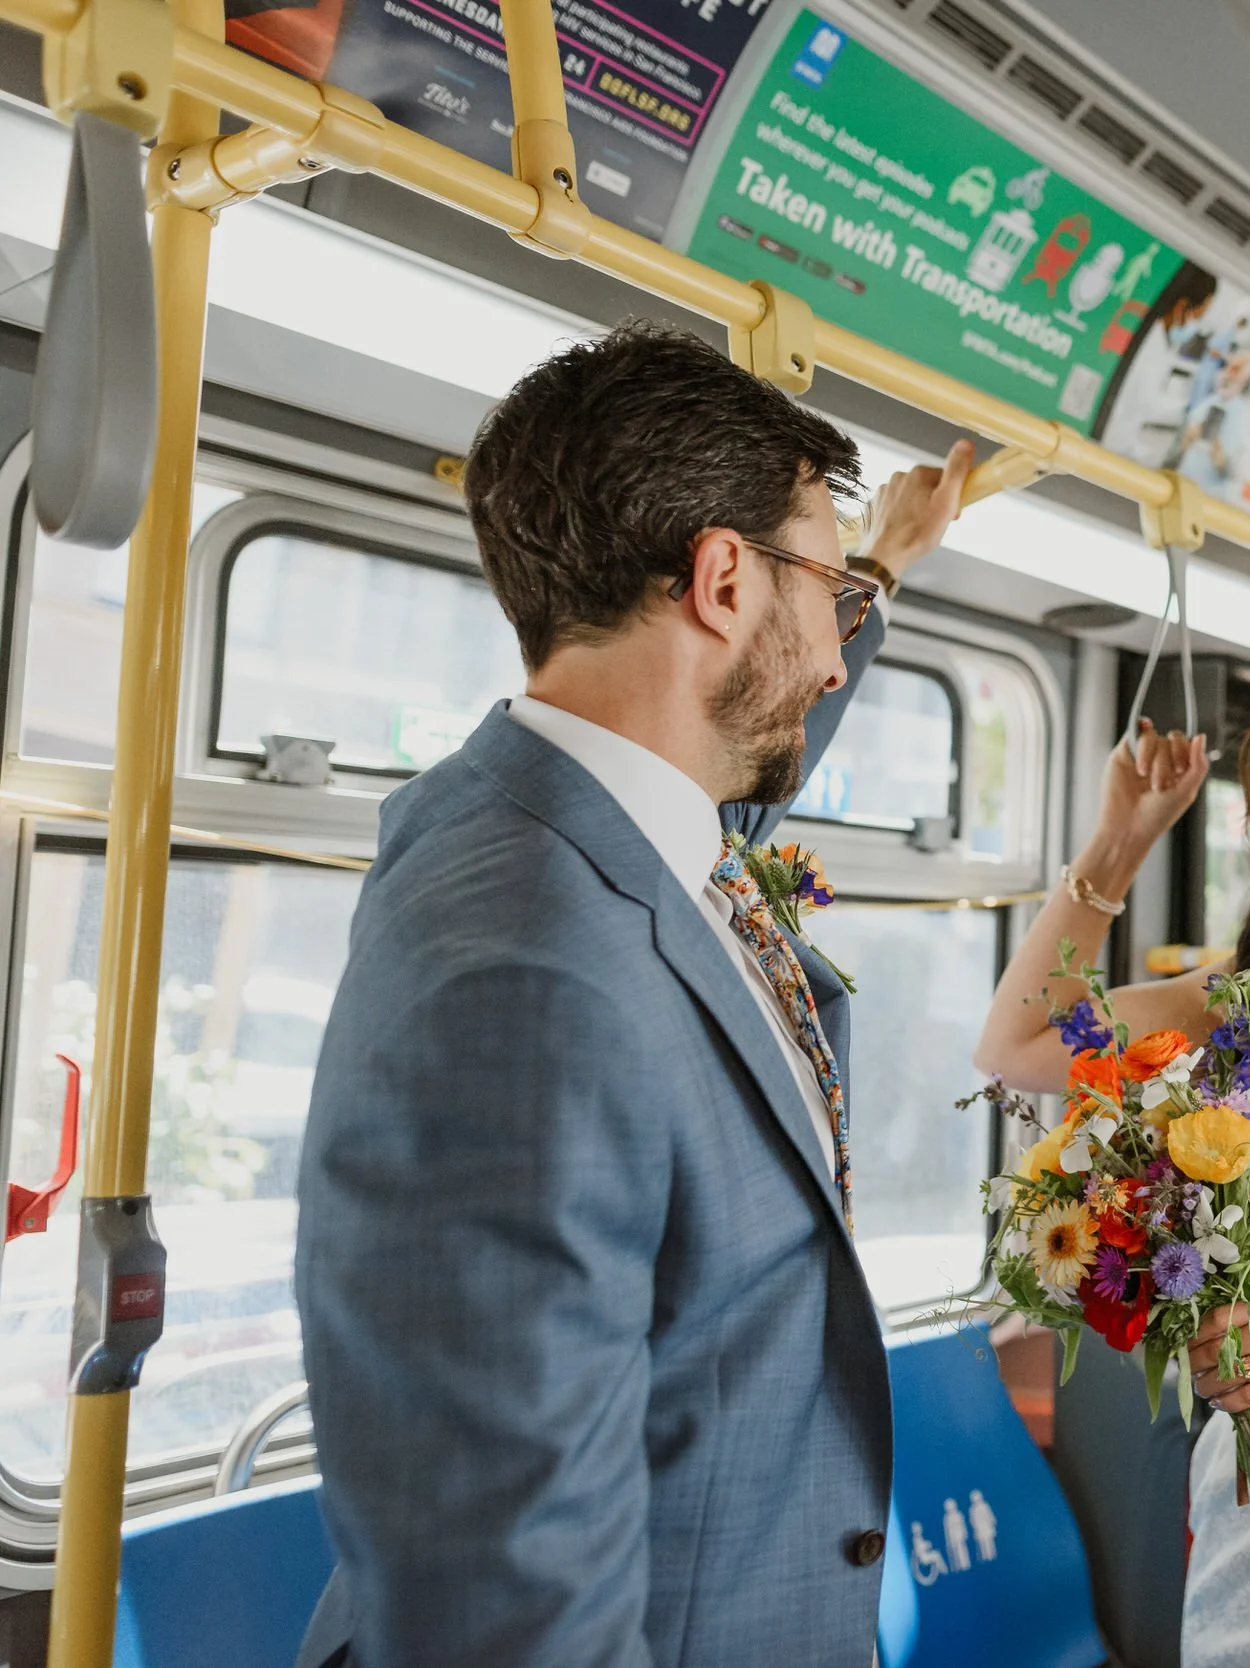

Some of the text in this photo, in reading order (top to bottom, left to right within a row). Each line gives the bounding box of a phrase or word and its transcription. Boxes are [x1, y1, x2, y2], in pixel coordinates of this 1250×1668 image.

[384, 1, 453, 44] SUPPORTING
[453, 34, 476, 56] THE
[756, 122, 971, 251] wherever you get your podcasts
[770, 90, 935, 199] Find the latest episodes
[736, 156, 1073, 359] Taken with Transportation
[120, 1288, 155, 1306] STOP
